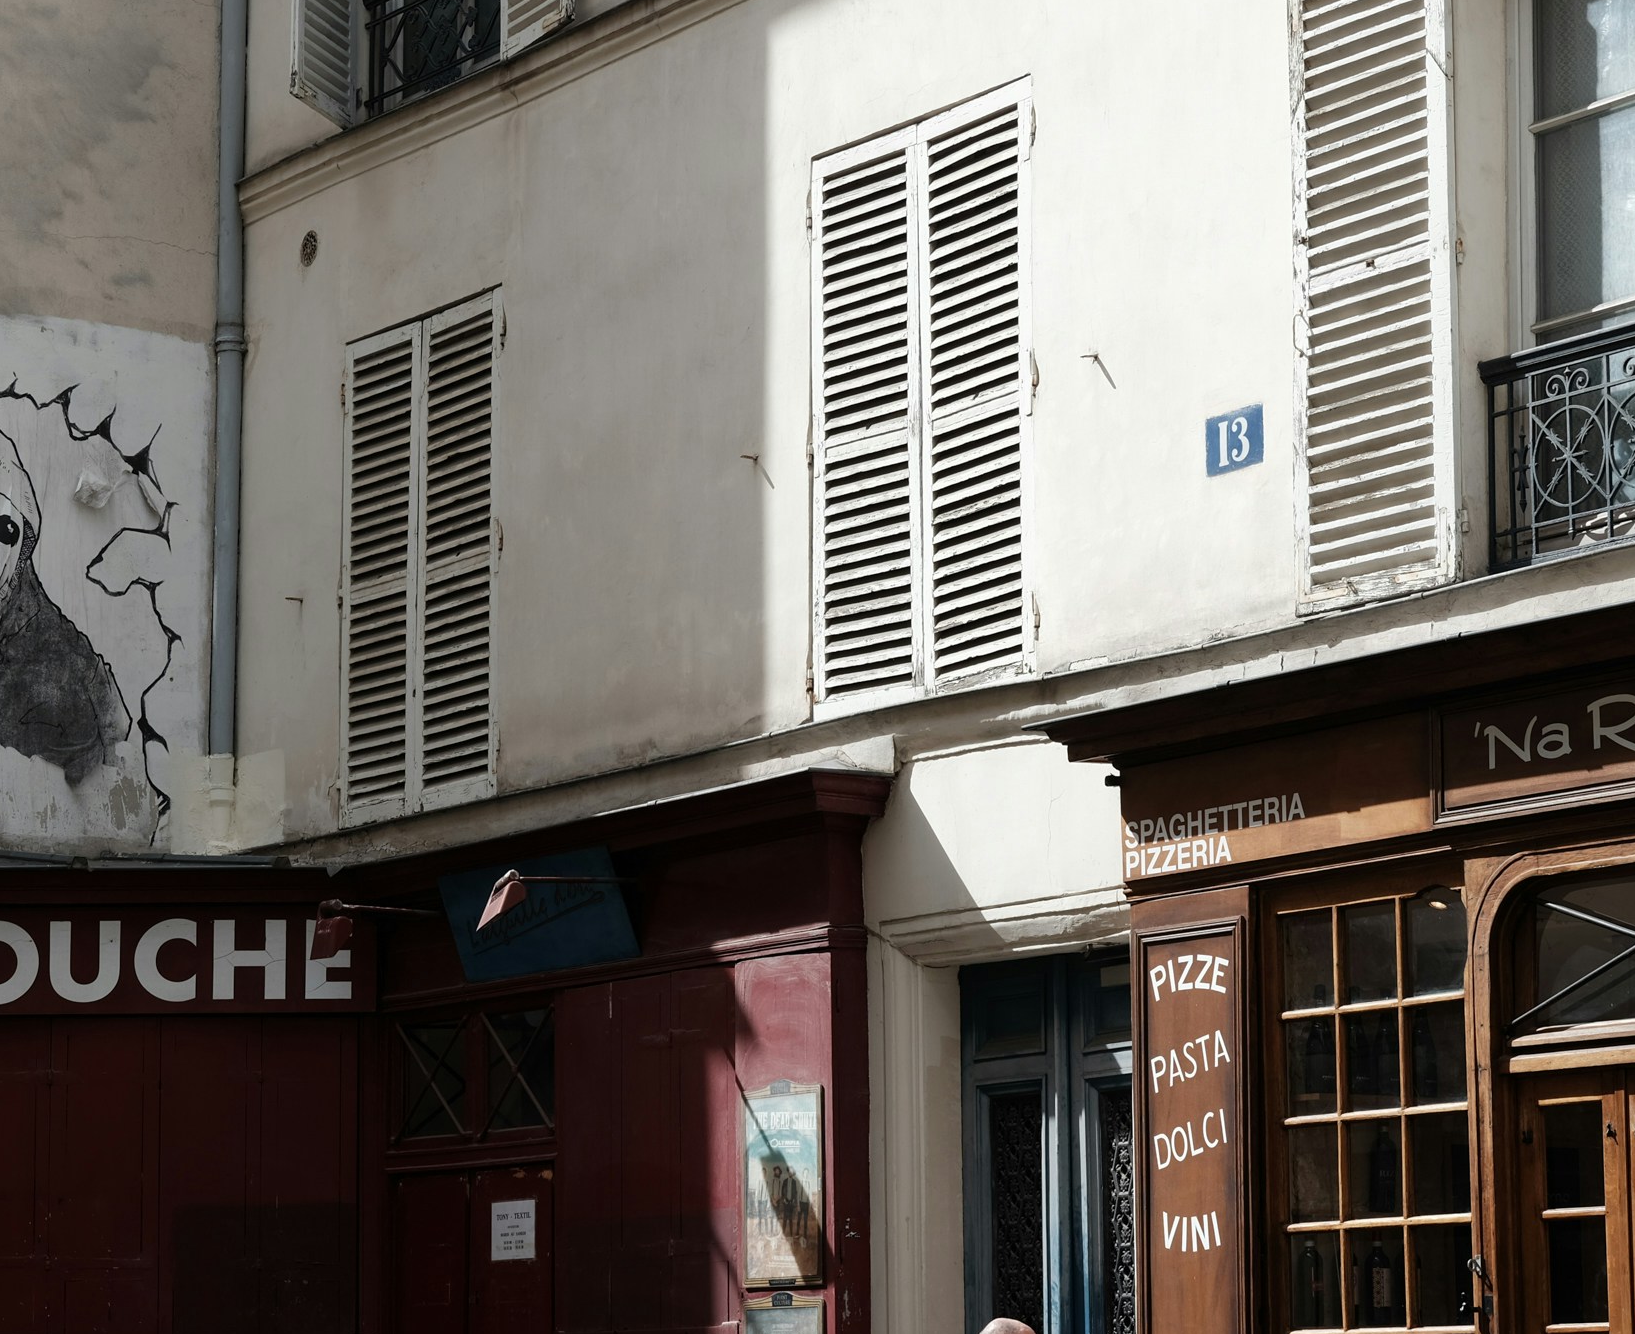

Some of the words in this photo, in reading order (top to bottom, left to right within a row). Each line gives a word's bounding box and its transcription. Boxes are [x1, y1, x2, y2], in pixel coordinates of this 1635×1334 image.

[1218, 416, 1250, 467] 13
[1124, 792, 1306, 849] SPAGHETTERIA
[1125, 835, 1232, 879] PIZZERIA
[1149, 954, 1229, 1002] PIZZE
[1150, 1029, 1231, 1093] PASTA
[770, 1111, 790, 1130] DEAD
[1153, 1108, 1228, 1170] DOLCI
[1162, 1210, 1221, 1253] VINI
